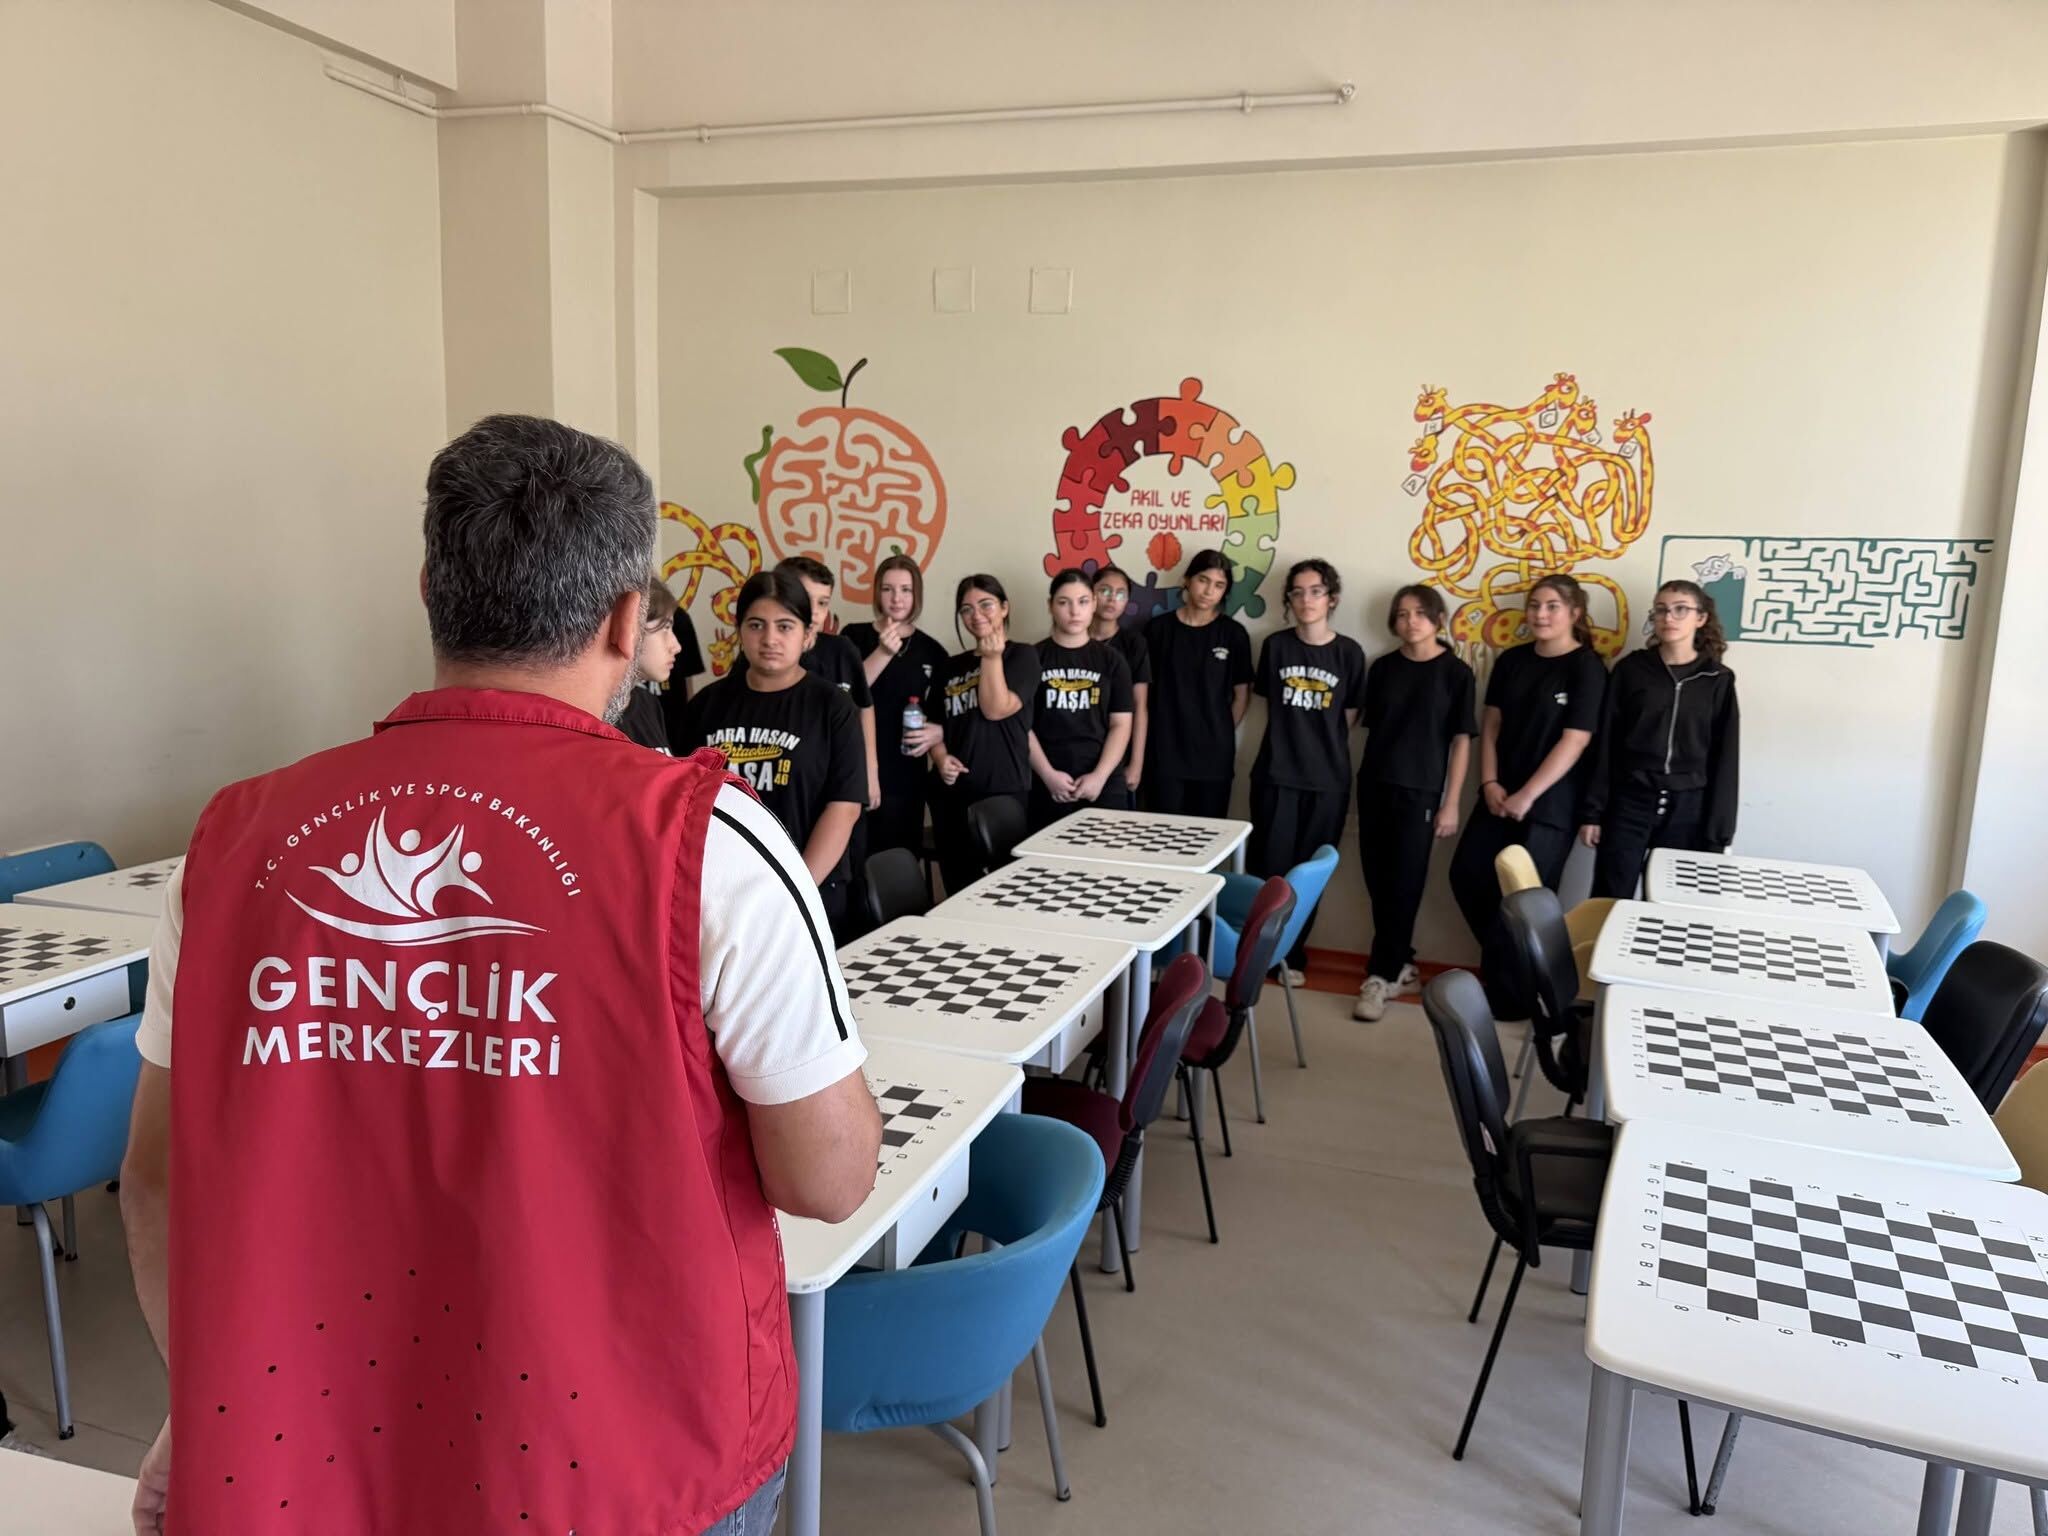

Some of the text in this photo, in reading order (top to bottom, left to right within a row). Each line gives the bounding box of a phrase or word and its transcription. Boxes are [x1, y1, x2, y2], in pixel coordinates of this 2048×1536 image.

[1130, 489, 1191, 508] AKIL VE
[1103, 512, 1225, 532] ZEKA OYUNLARI
[1046, 689, 1090, 713] PAŞA
[707, 727, 800, 751] KARA HASAN
[255, 783, 582, 897] T.C. GENÇLİK VE SPOR BAKANLIĞI
[248, 955, 559, 1024] GENÇLİK
[242, 1021, 561, 1077] MERKEZLERİ
